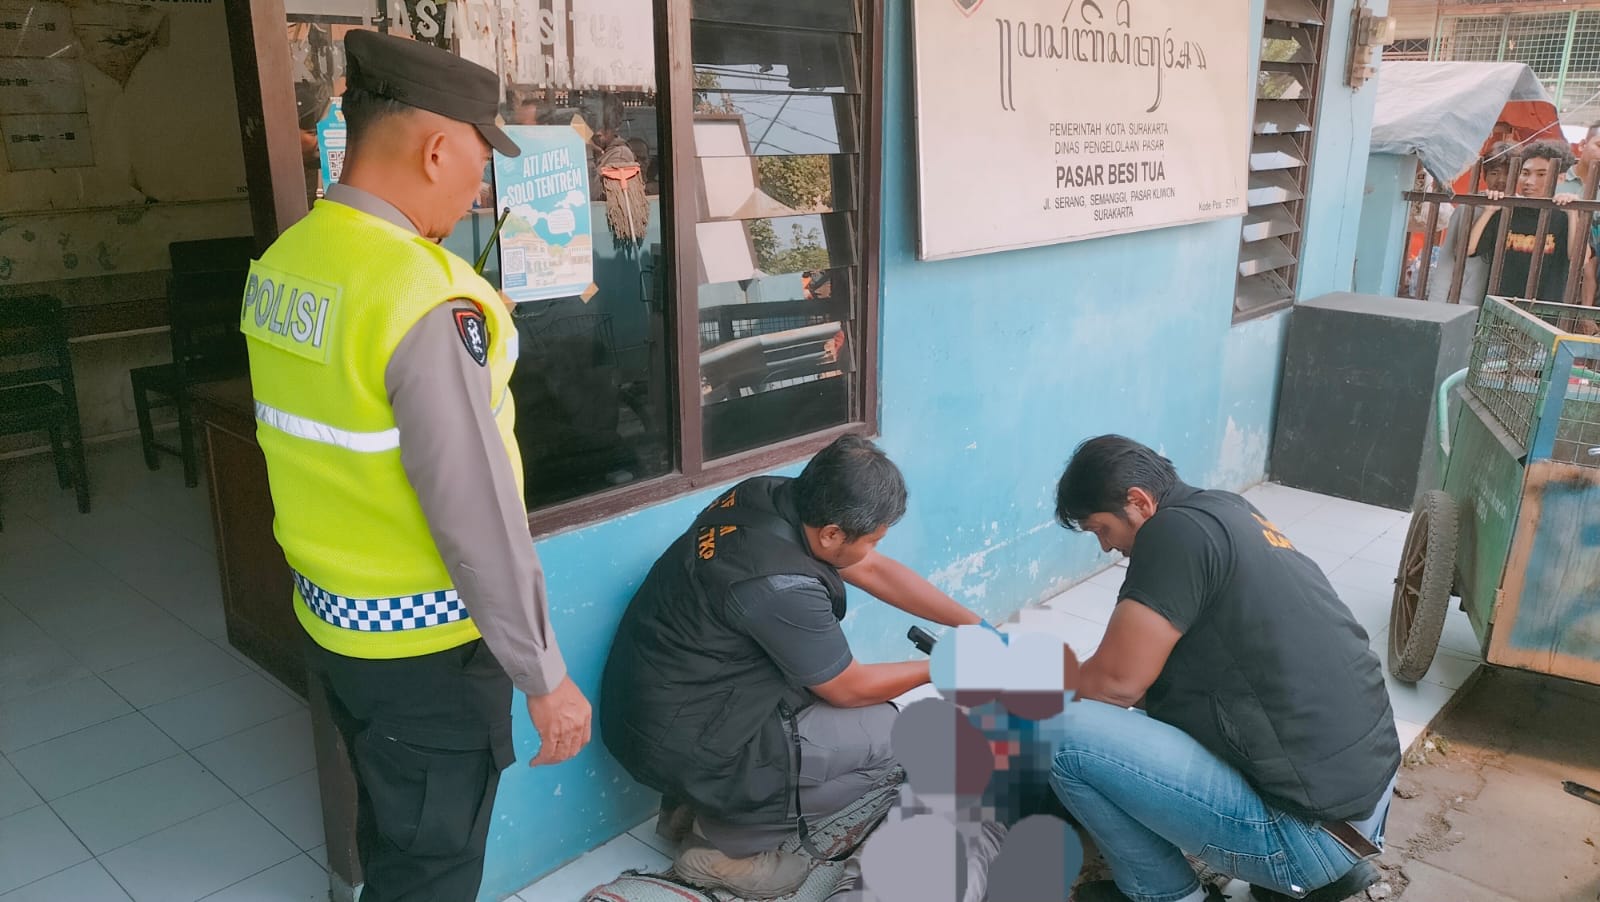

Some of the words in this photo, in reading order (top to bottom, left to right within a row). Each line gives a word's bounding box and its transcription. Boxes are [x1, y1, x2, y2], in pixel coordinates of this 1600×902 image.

[1049, 122, 1101, 137] PEMERINTAH
[1105, 122, 1126, 135] KOTA
[1128, 122, 1169, 135] SURAKARTA
[1054, 141, 1080, 155] DINAS
[1084, 140, 1140, 154] PENGELOLAAN
[1142, 139, 1165, 152] PASAR
[523, 155, 540, 178] ATI
[541, 147, 575, 176] AYEM,
[1056, 164, 1104, 188] PASAR
[1108, 162, 1138, 185] BESI
[1141, 160, 1165, 183] TUA
[506, 181, 535, 207] SOLO
[1054, 195, 1087, 210] SERANG,
[1090, 191, 1128, 207] SEMANGGI,
[1130, 189, 1152, 202] PASAR
[1152, 186, 1175, 200] KLIWON
[1093, 206, 1134, 222] SURAKARTA
[243, 273, 329, 348] POLISI
